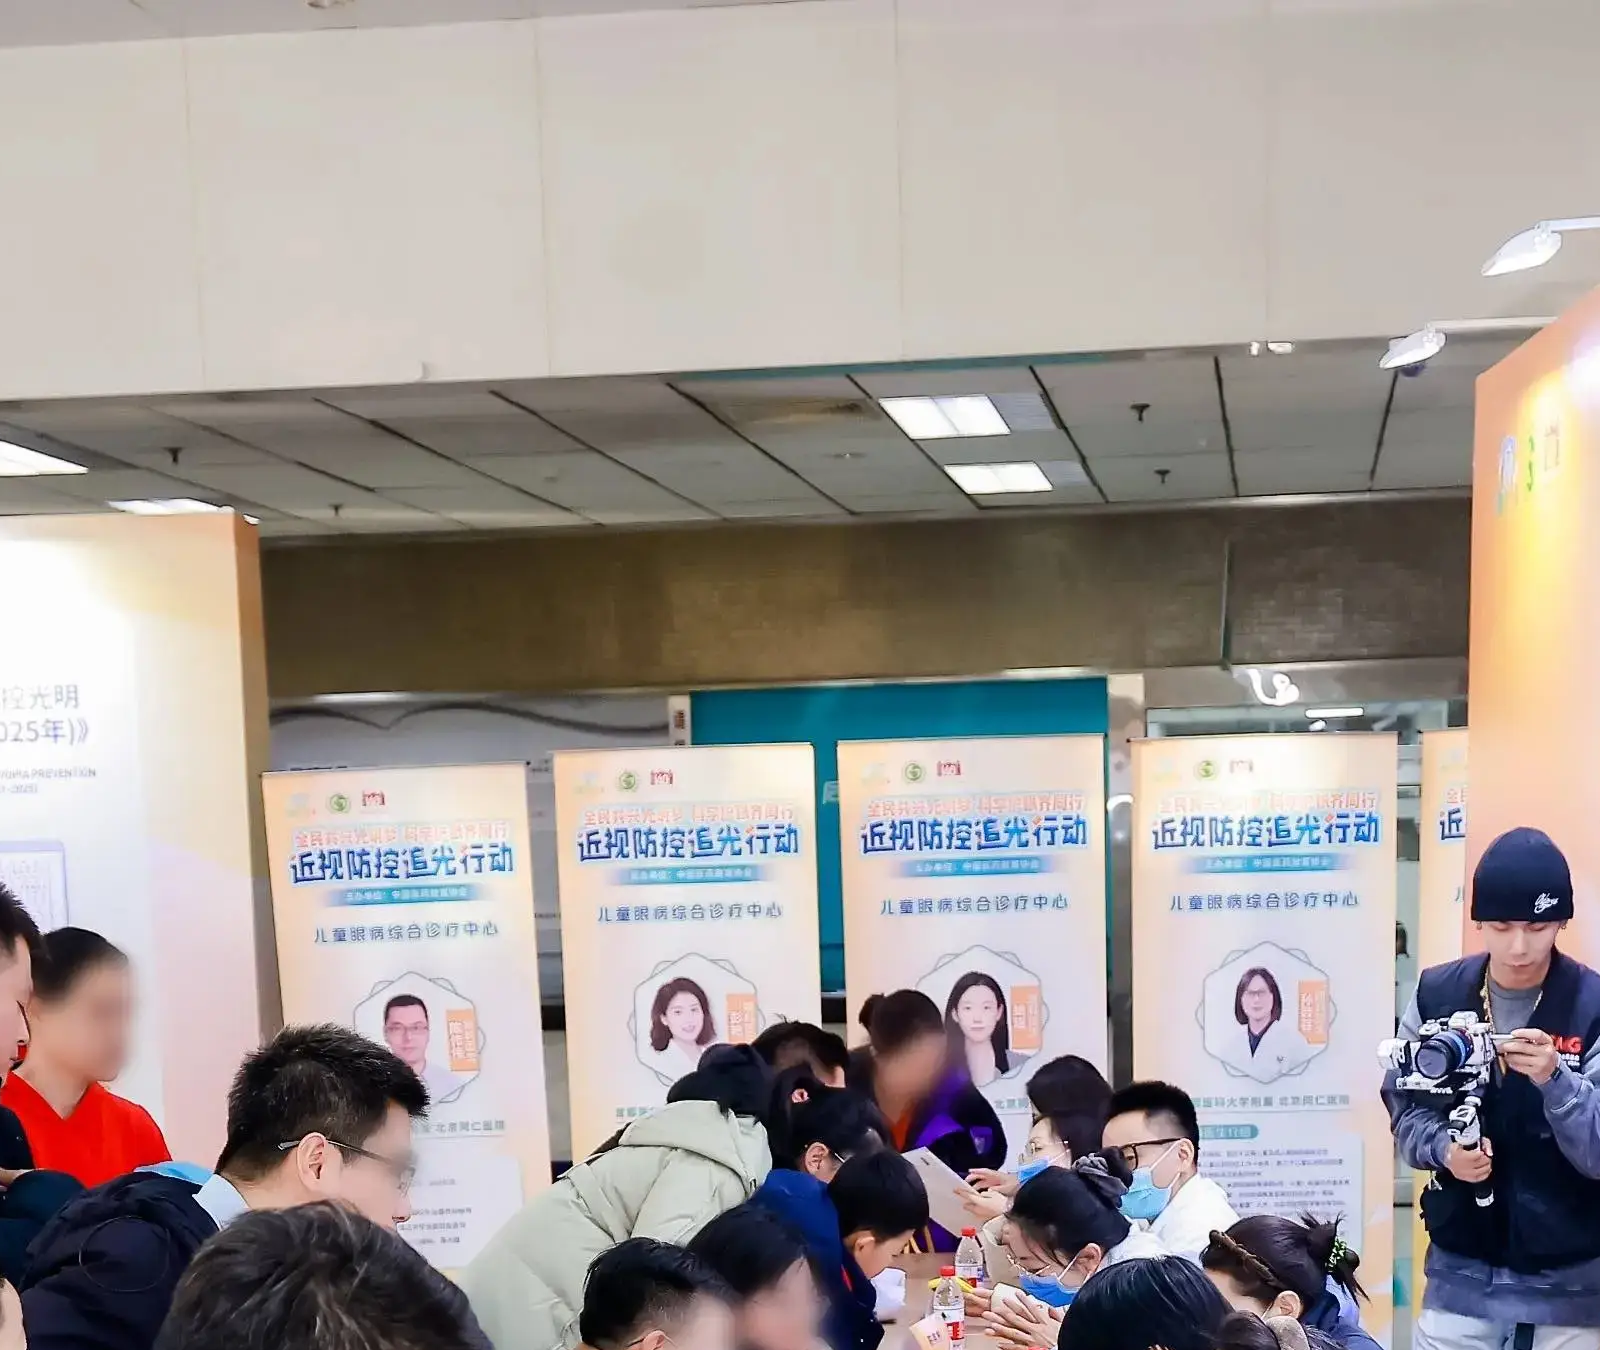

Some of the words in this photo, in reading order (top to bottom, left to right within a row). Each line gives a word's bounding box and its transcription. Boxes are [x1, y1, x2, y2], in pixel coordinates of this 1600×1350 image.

[577, 823, 799, 862] 近视防控追光行动
[861, 813, 1088, 854] 近视防控追光行动
[1152, 811, 1381, 849] 近视防控追光行动
[290, 842, 514, 884] 近视防控追光行动
[598, 902, 782, 922] 儿童眼病综合诊疗中心
[880, 894, 1068, 915] 儿童眼病综合诊疗中心
[1170, 891, 1358, 911] 儿童眼病综合诊疗中心
[314, 921, 498, 944] 儿童眼病综合诊疗中心
